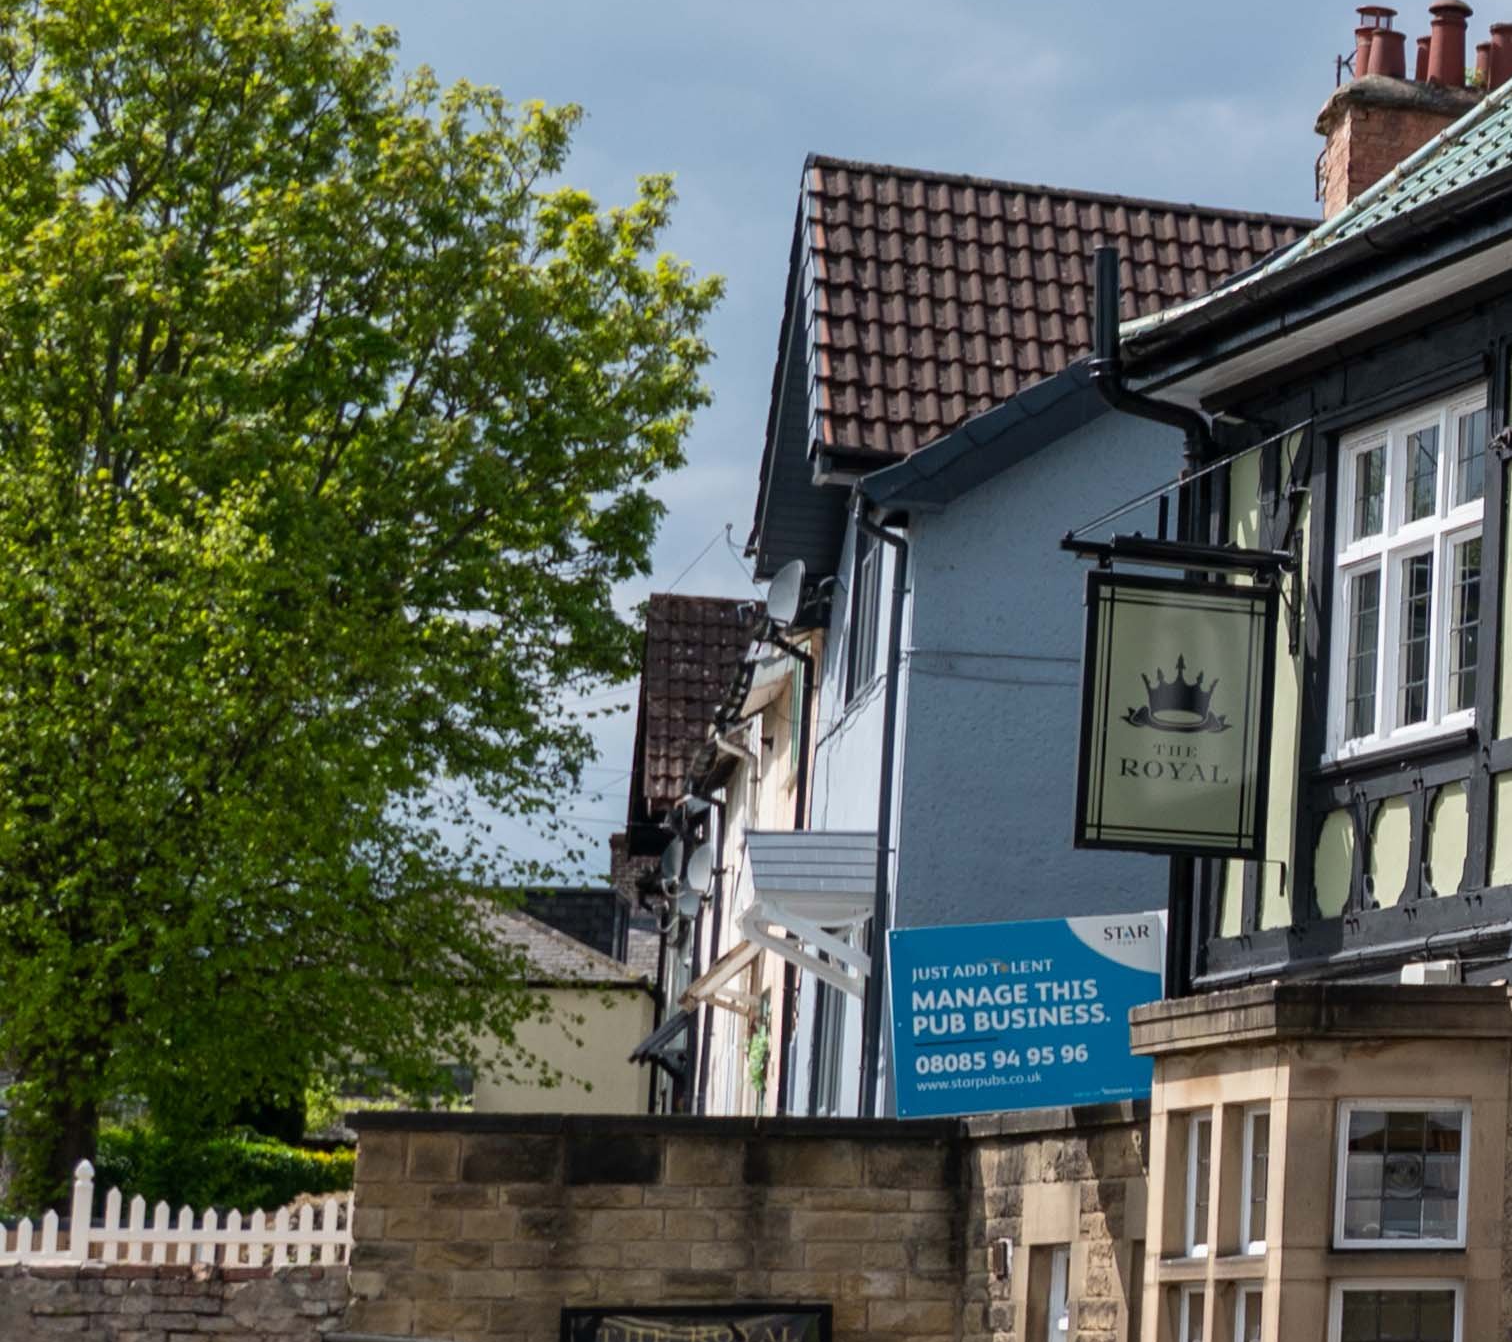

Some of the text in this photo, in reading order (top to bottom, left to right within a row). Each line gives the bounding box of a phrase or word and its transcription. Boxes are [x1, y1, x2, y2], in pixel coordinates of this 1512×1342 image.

[1153, 743, 1198, 757] THE
[1119, 756, 1229, 784] ROYAL
[1104, 924, 1150, 941] STAR
[912, 958, 1053, 983] JUST ADD TLENT
[912, 978, 1098, 1012] MANAGE THIS
[913, 1003, 1111, 1037] PUB BUSINESS.
[915, 1044, 1089, 1075] 08085 94 95 96
[916, 1070, 1042, 1092] www.starpubs.co.uk
